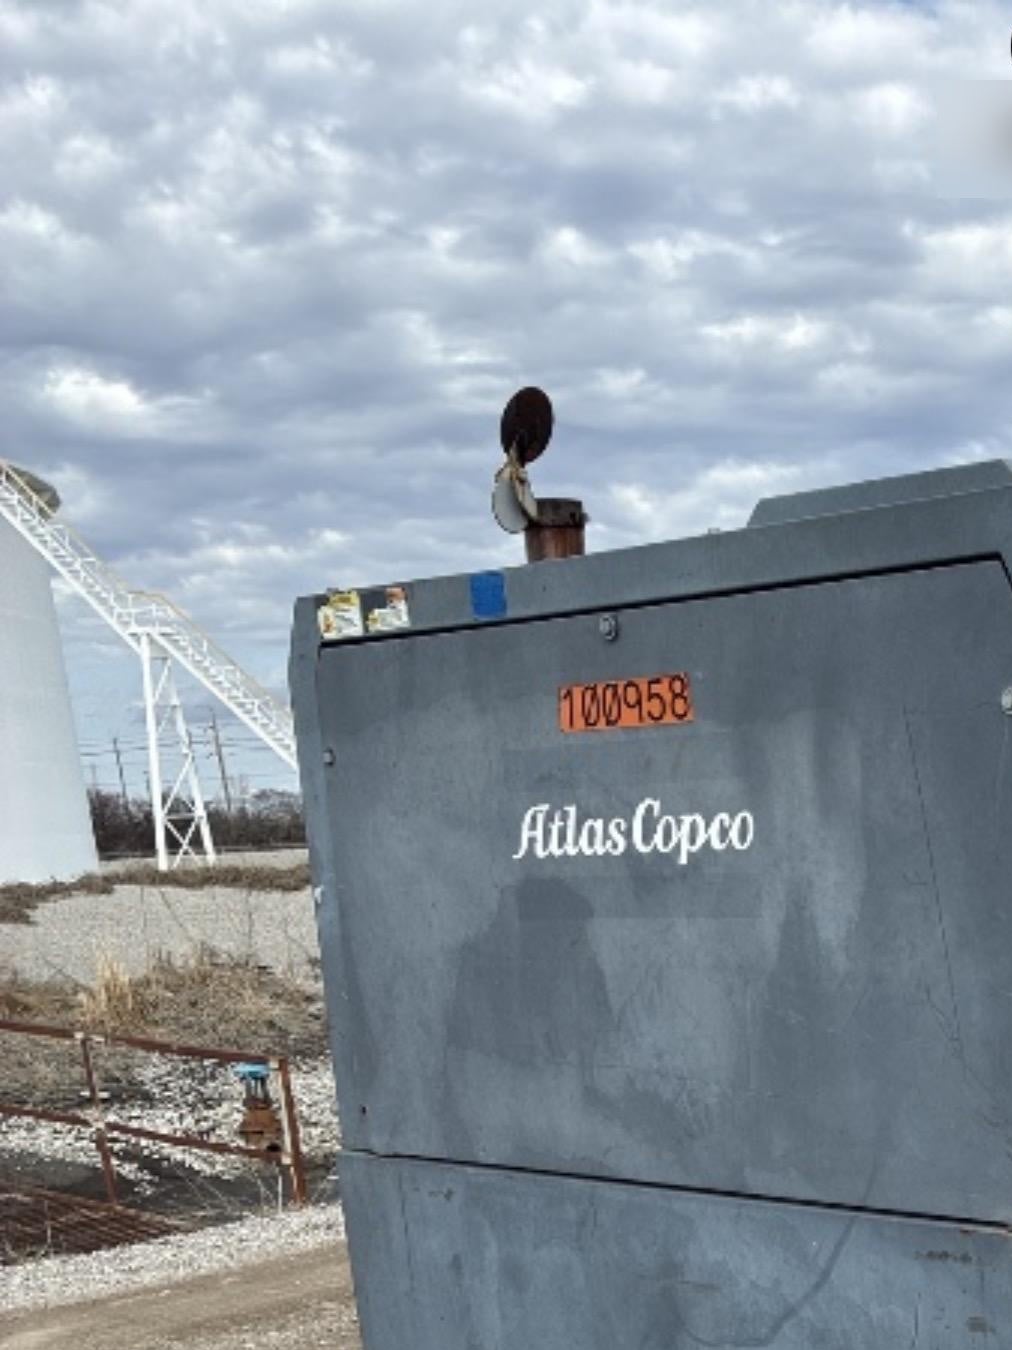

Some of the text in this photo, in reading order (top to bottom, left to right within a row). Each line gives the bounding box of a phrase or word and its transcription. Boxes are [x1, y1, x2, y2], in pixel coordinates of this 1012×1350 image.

[562, 674, 691, 729] 100958
[511, 797, 755, 865] Atlas Copco
